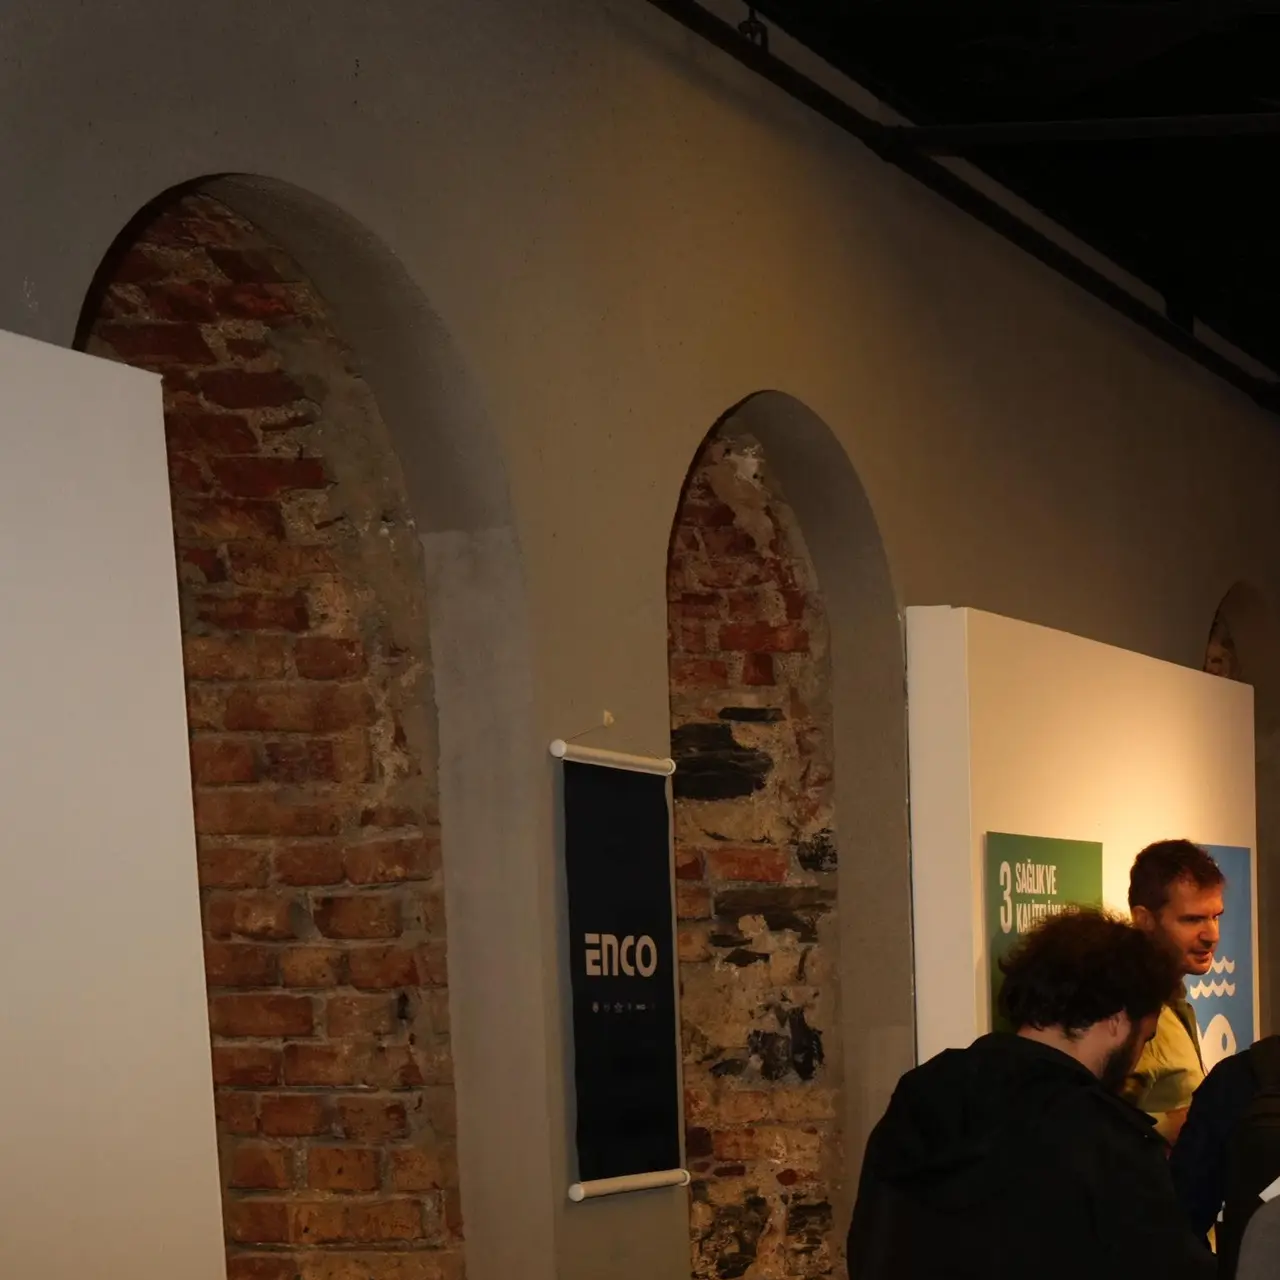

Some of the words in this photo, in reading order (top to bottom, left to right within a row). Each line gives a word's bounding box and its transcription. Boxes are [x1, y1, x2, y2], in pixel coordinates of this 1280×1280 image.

[999, 861, 1012, 934] 3
[1015, 858, 1045, 894] SAĞLIK
[1045, 865, 1057, 895] VE
